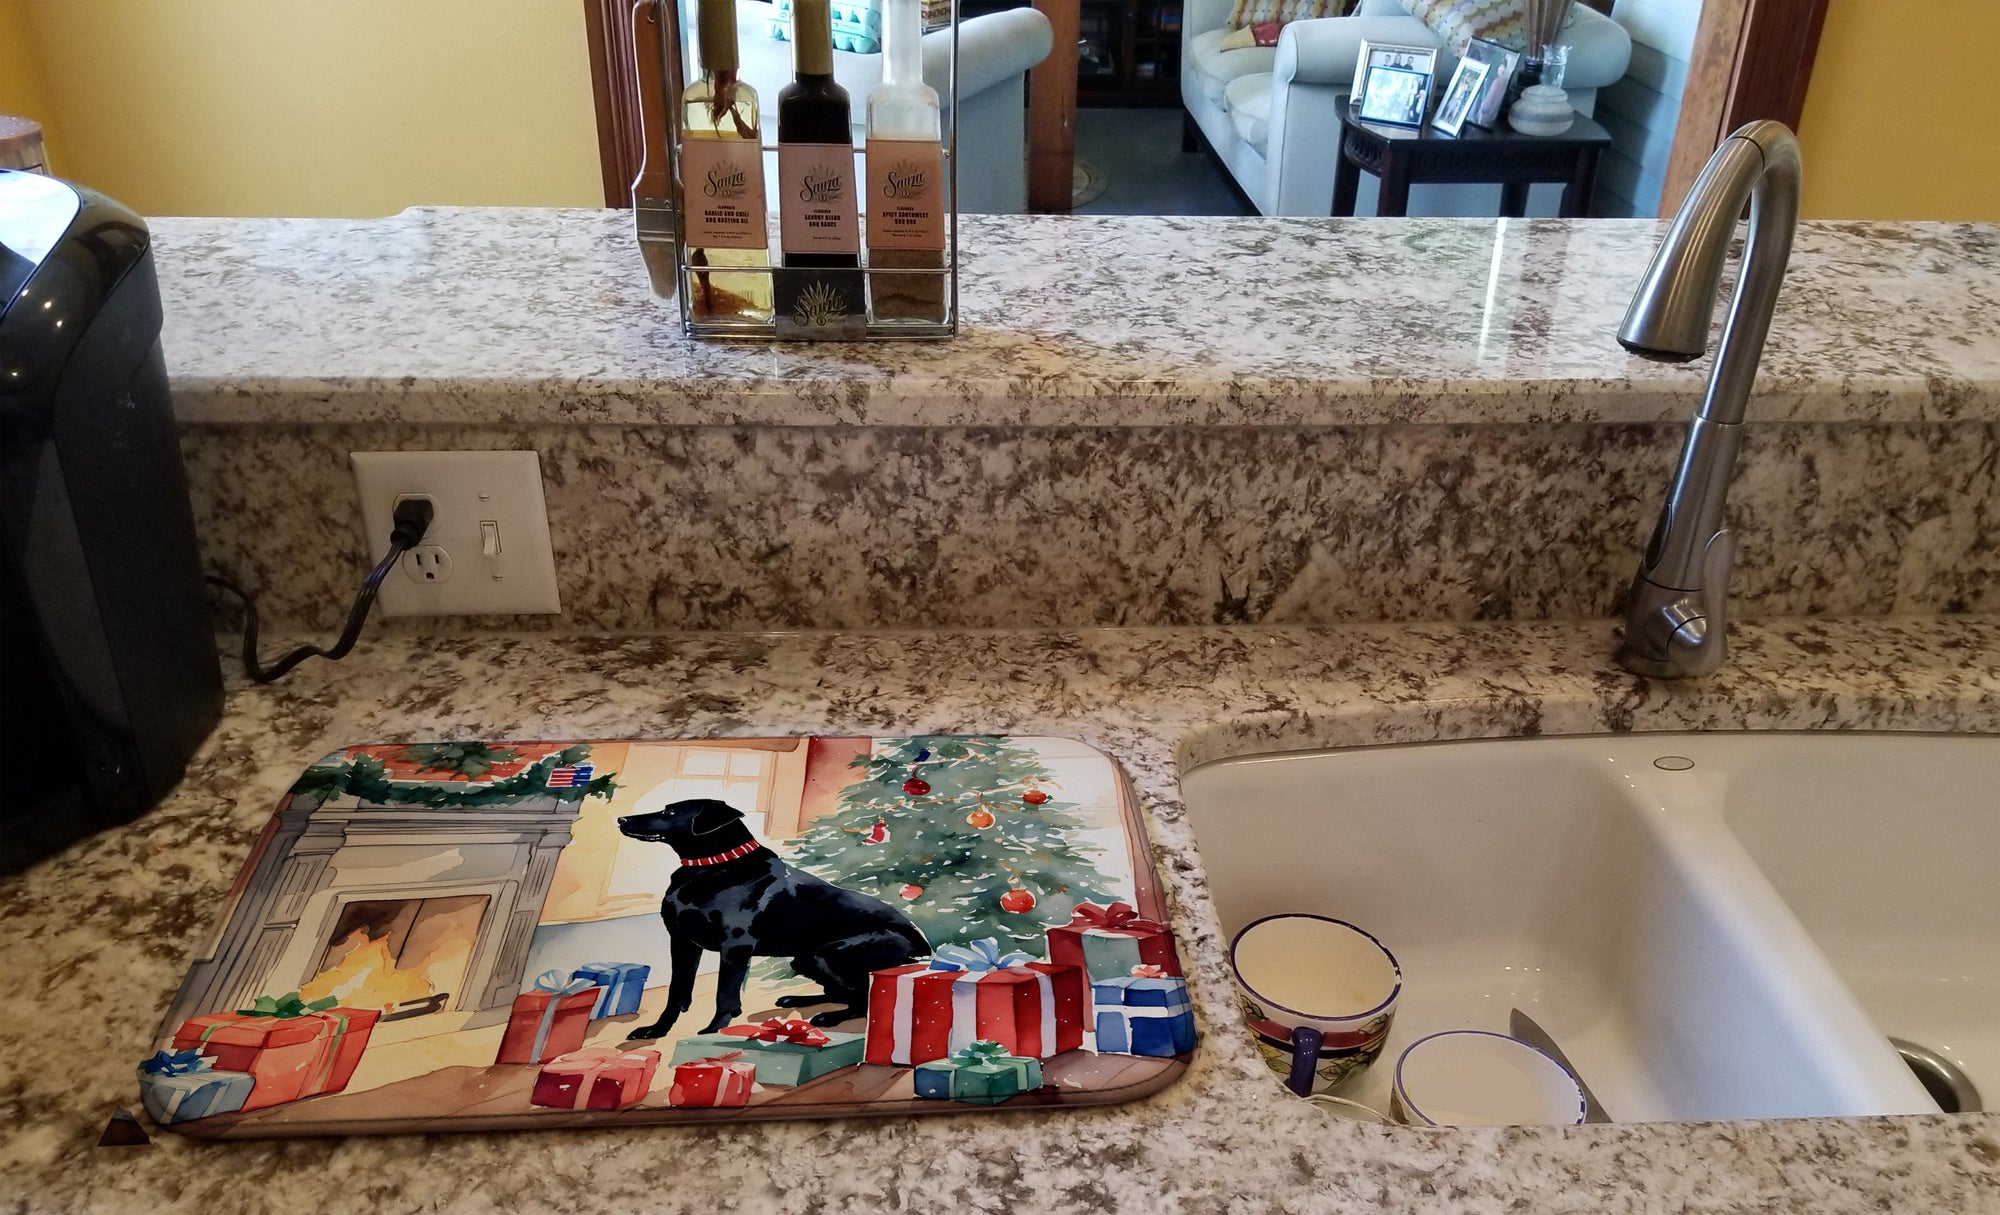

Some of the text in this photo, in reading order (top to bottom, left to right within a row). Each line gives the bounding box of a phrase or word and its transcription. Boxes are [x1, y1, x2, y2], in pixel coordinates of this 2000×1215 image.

[704, 169, 746, 197] Sauza
[800, 175, 842, 202] Sauza
[884, 171, 925, 198] Sauza
[898, 211, 929, 219] SOUTHWEST
[793, 295, 845, 327] Sauza
